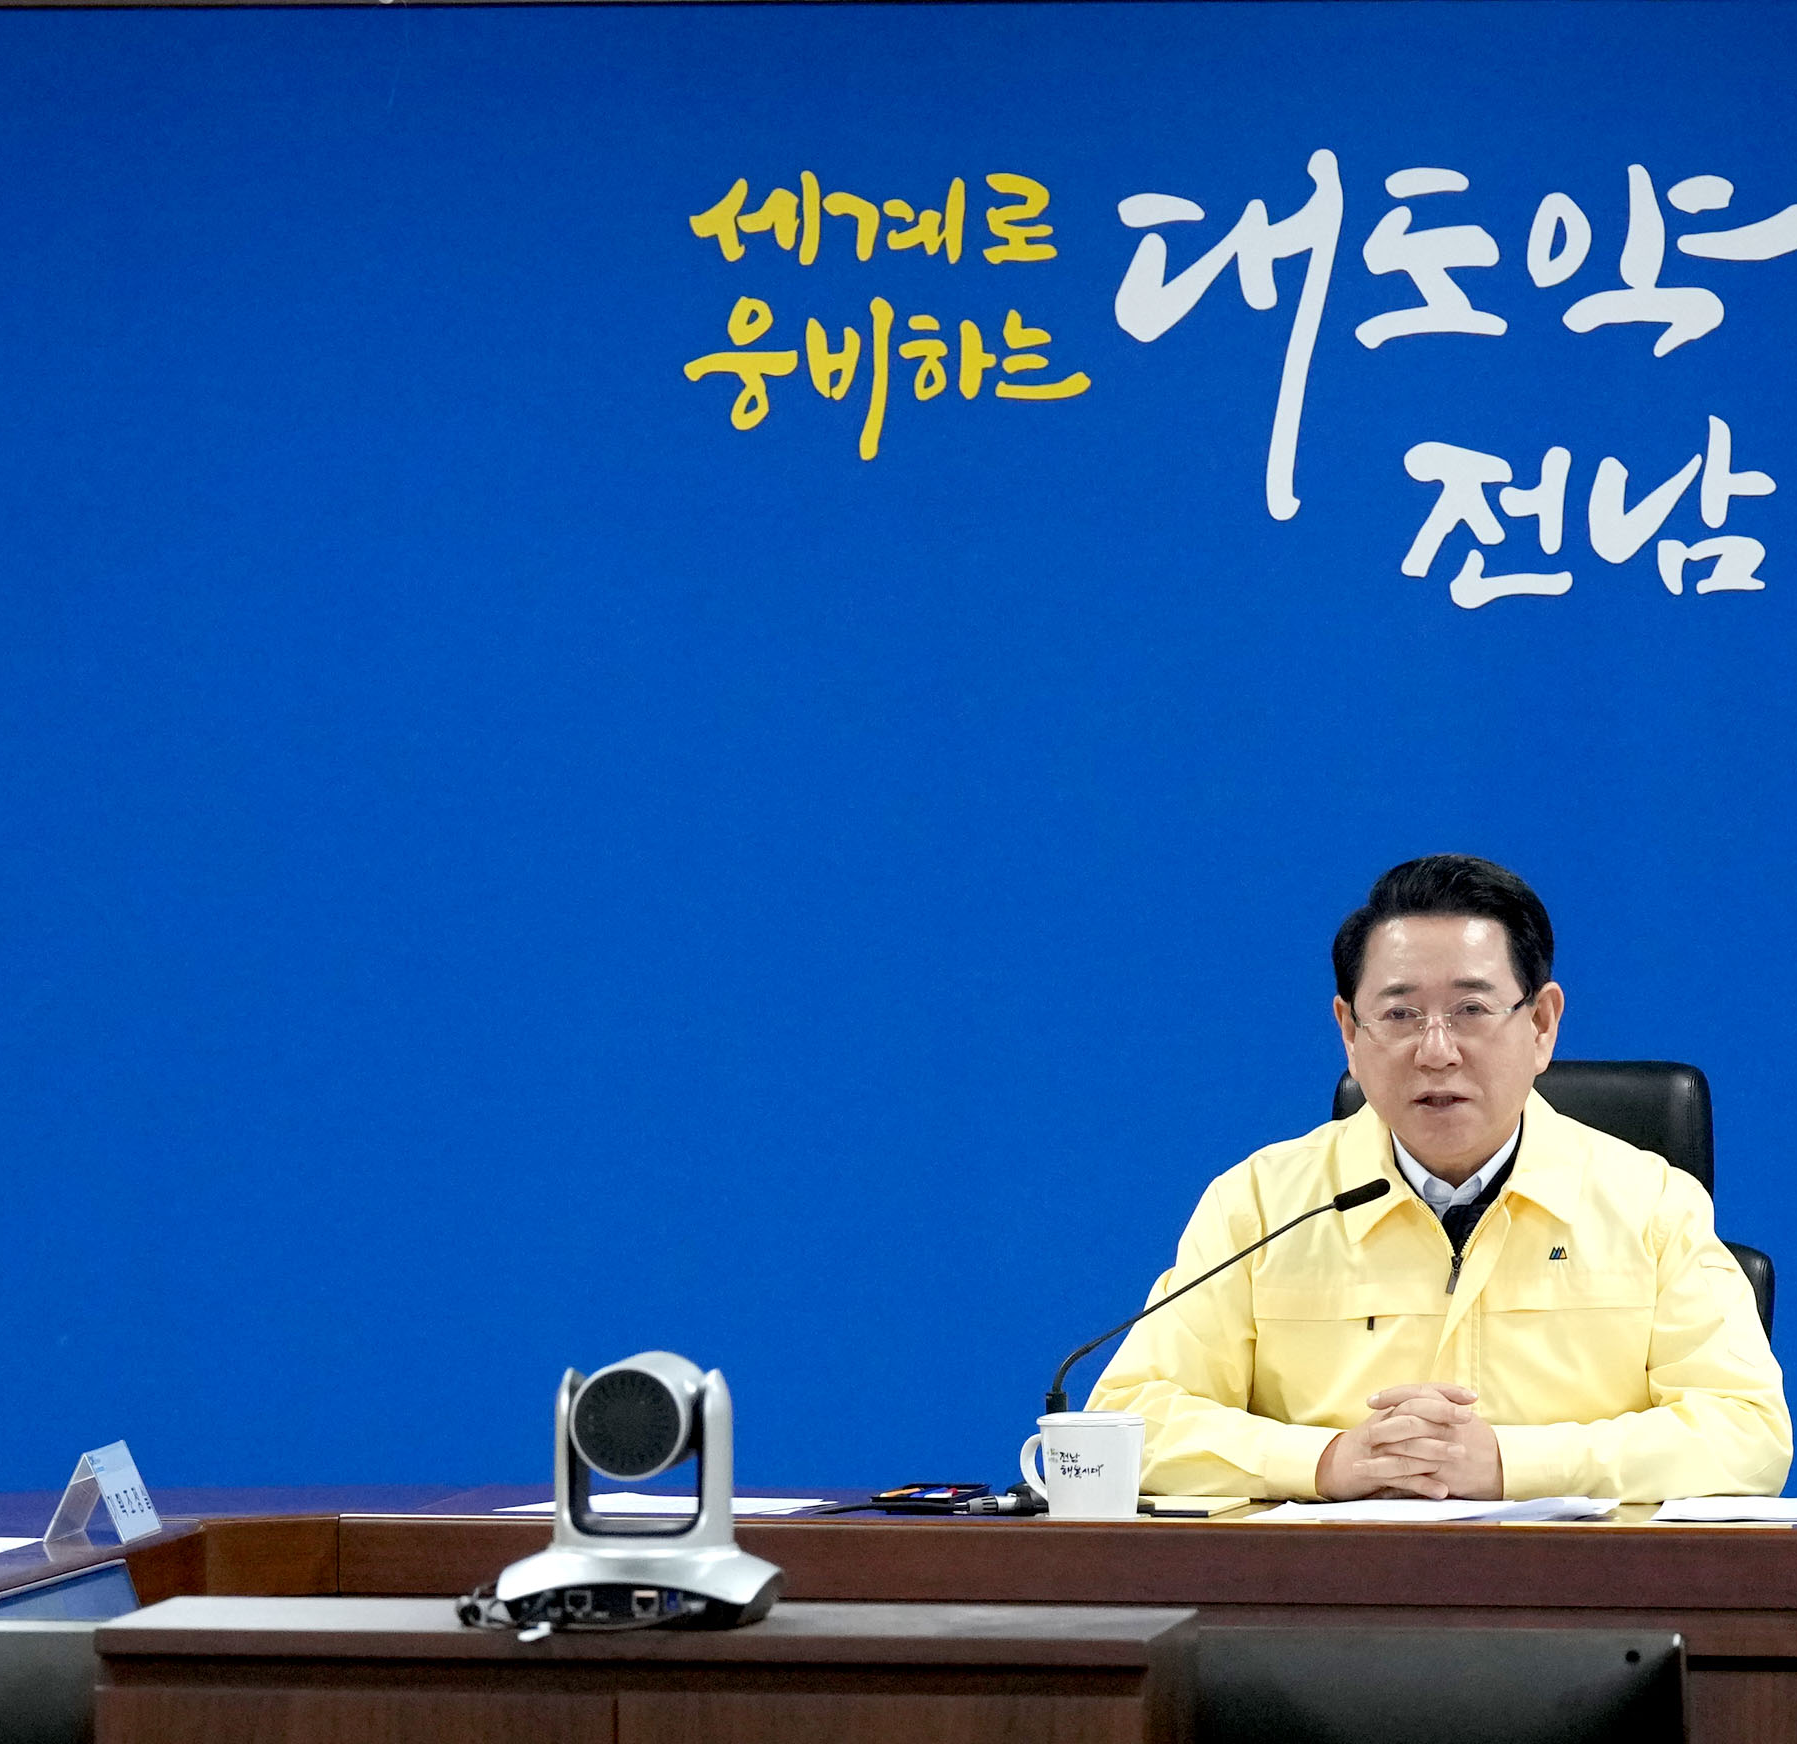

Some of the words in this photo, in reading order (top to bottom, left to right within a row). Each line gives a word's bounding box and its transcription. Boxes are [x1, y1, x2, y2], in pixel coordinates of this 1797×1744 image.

[690, 172, 1057, 265] 세계로
[684, 297, 1090, 460] 웅비하는
[1400, 416, 1776, 608] 전남
[1059, 1451, 1080, 1463] 전남
